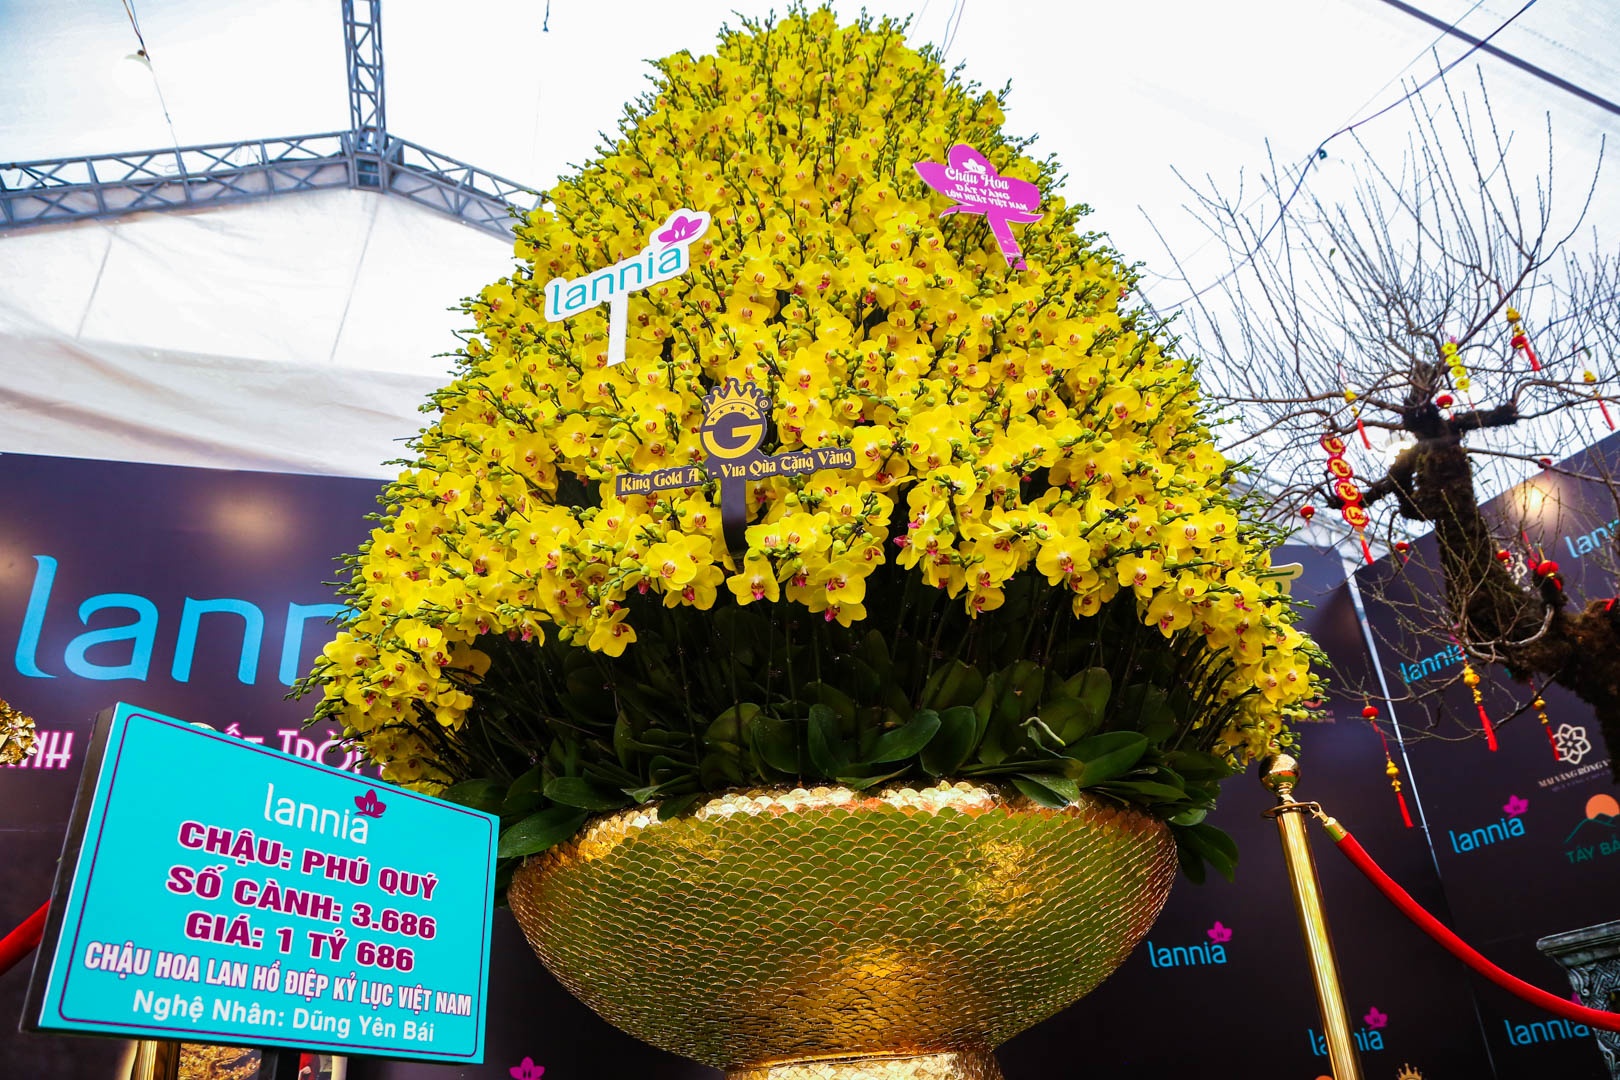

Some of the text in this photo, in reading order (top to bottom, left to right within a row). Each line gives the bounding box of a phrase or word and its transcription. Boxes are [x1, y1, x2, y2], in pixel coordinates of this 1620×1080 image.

[980, 173, 1010, 190] Hoa
[1008, 202, 1029, 211] NAM
[553, 248, 681, 315] lannia
[620, 477, 651, 492] King
[653, 471, 683, 487] Gold
[720, 464, 746, 478] Vua
[780, 456, 815, 473] Tặng
[817, 451, 853, 466] Vàng
[1400, 644, 1470, 684] lannia
[264, 783, 369, 844] lannia
[1448, 817, 1526, 854] lannia
[178, 821, 439, 900] CHẬU: PHÚ QUÝ
[166, 864, 437, 940] SỐ CÀNH: 3.686
[184, 910, 416, 973] GIÁ: 1 TỶ 686
[1147, 940, 1227, 968] lannia
[83, 941, 152, 980] CHẬU
[153, 951, 201, 983] HOA
[204, 957, 249, 990] LAN
[283, 968, 329, 1002] ĐIỆP
[332, 971, 358, 1003] KỶ
[360, 979, 394, 1011] LỤC
[397, 983, 433, 1016] VIỆT
[435, 990, 472, 1017] NAM
[132, 989, 435, 1043] Nghệ Nhân: Dũng Yên Bái
[1503, 1018, 1591, 1046] lannia
